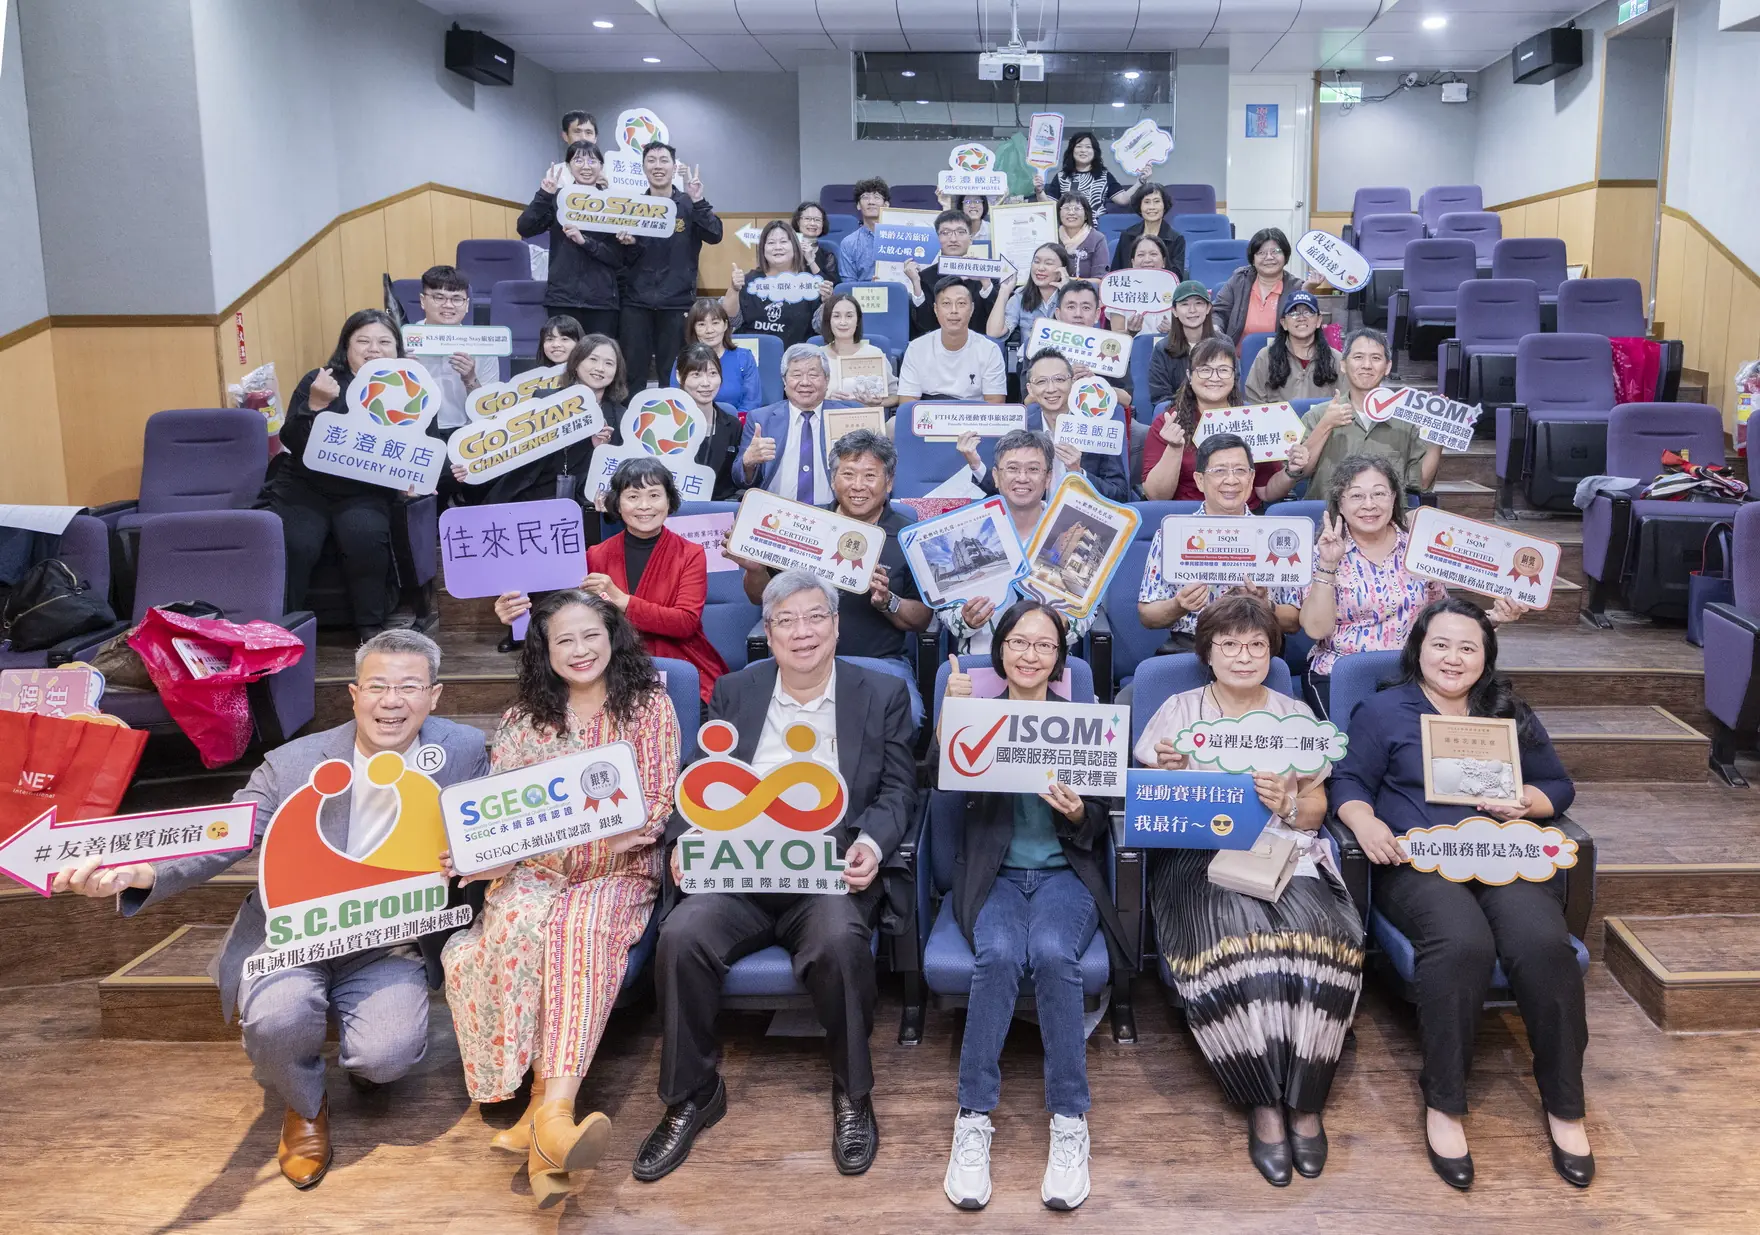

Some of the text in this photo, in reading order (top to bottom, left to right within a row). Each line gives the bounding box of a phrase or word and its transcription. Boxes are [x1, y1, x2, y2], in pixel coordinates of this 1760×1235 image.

[613, 160, 644, 175] 澎澄
[613, 177, 649, 186] DISCOVER
[945, 175, 1000, 184] 澎澄飯店
[566, 192, 668, 219] GO STAR
[566, 212, 640, 227] CHALLENGE
[879, 230, 929, 242] 樂齡友善旅宿
[1306, 245, 1346, 281] 旅館達人
[1113, 291, 1161, 304] 民宿達人
[754, 320, 786, 332] DUCK
[1040, 327, 1095, 349] SGEQC
[1405, 389, 1469, 424] ISQM
[459, 395, 588, 459] GO STAR
[1061, 421, 1118, 439] 澎澄飯店
[1203, 418, 1254, 436] 用心連結
[1393, 407, 1471, 438] 國際服務品質認證
[323, 425, 434, 467] 澎澄飯店
[468, 414, 592, 474] CHALLENGE 星探索
[1060, 436, 1117, 449] DISCOVERY HOTEL
[1244, 432, 1281, 446] 務無界
[1428, 431, 1469, 451] 國家標章
[317, 449, 425, 483] DISCOVERY HOTEL
[793, 521, 812, 532] ISQM
[443, 518, 580, 562] 佳來民宿
[779, 529, 819, 546] CERTIFIED
[1466, 538, 1486, 548] ISQM
[1453, 546, 1494, 563] CERTIFIED
[840, 575, 857, 588] 金級
[1174, 572, 1299, 583] ISQM國際服務品質認證 銀級
[1416, 562, 1513, 596] ISQM國際服務品質認證
[1008, 715, 1103, 746] ISQM
[1209, 733, 1330, 752] 這裡是您第二個家
[996, 746, 1118, 768] 國際服務品質認證
[590, 770, 610, 786] 銀獎
[1057, 769, 1117, 788] 國家標章
[460, 777, 569, 826] SGEQC
[1136, 784, 1245, 804] 運動賽事住宿
[465, 805, 573, 842] SGEQC 永續品質認證
[475, 813, 623, 863] SGEQC永續品質認證 銀級
[682, 839, 845, 872] FAYOL
[1410, 841, 1540, 858] 貼心服務都是為您
[685, 877, 847, 891] 法約爾國際認證機構
[269, 885, 445, 946] S.C.Group
[247, 907, 471, 977] 興誠服務品質管理訓練機構
